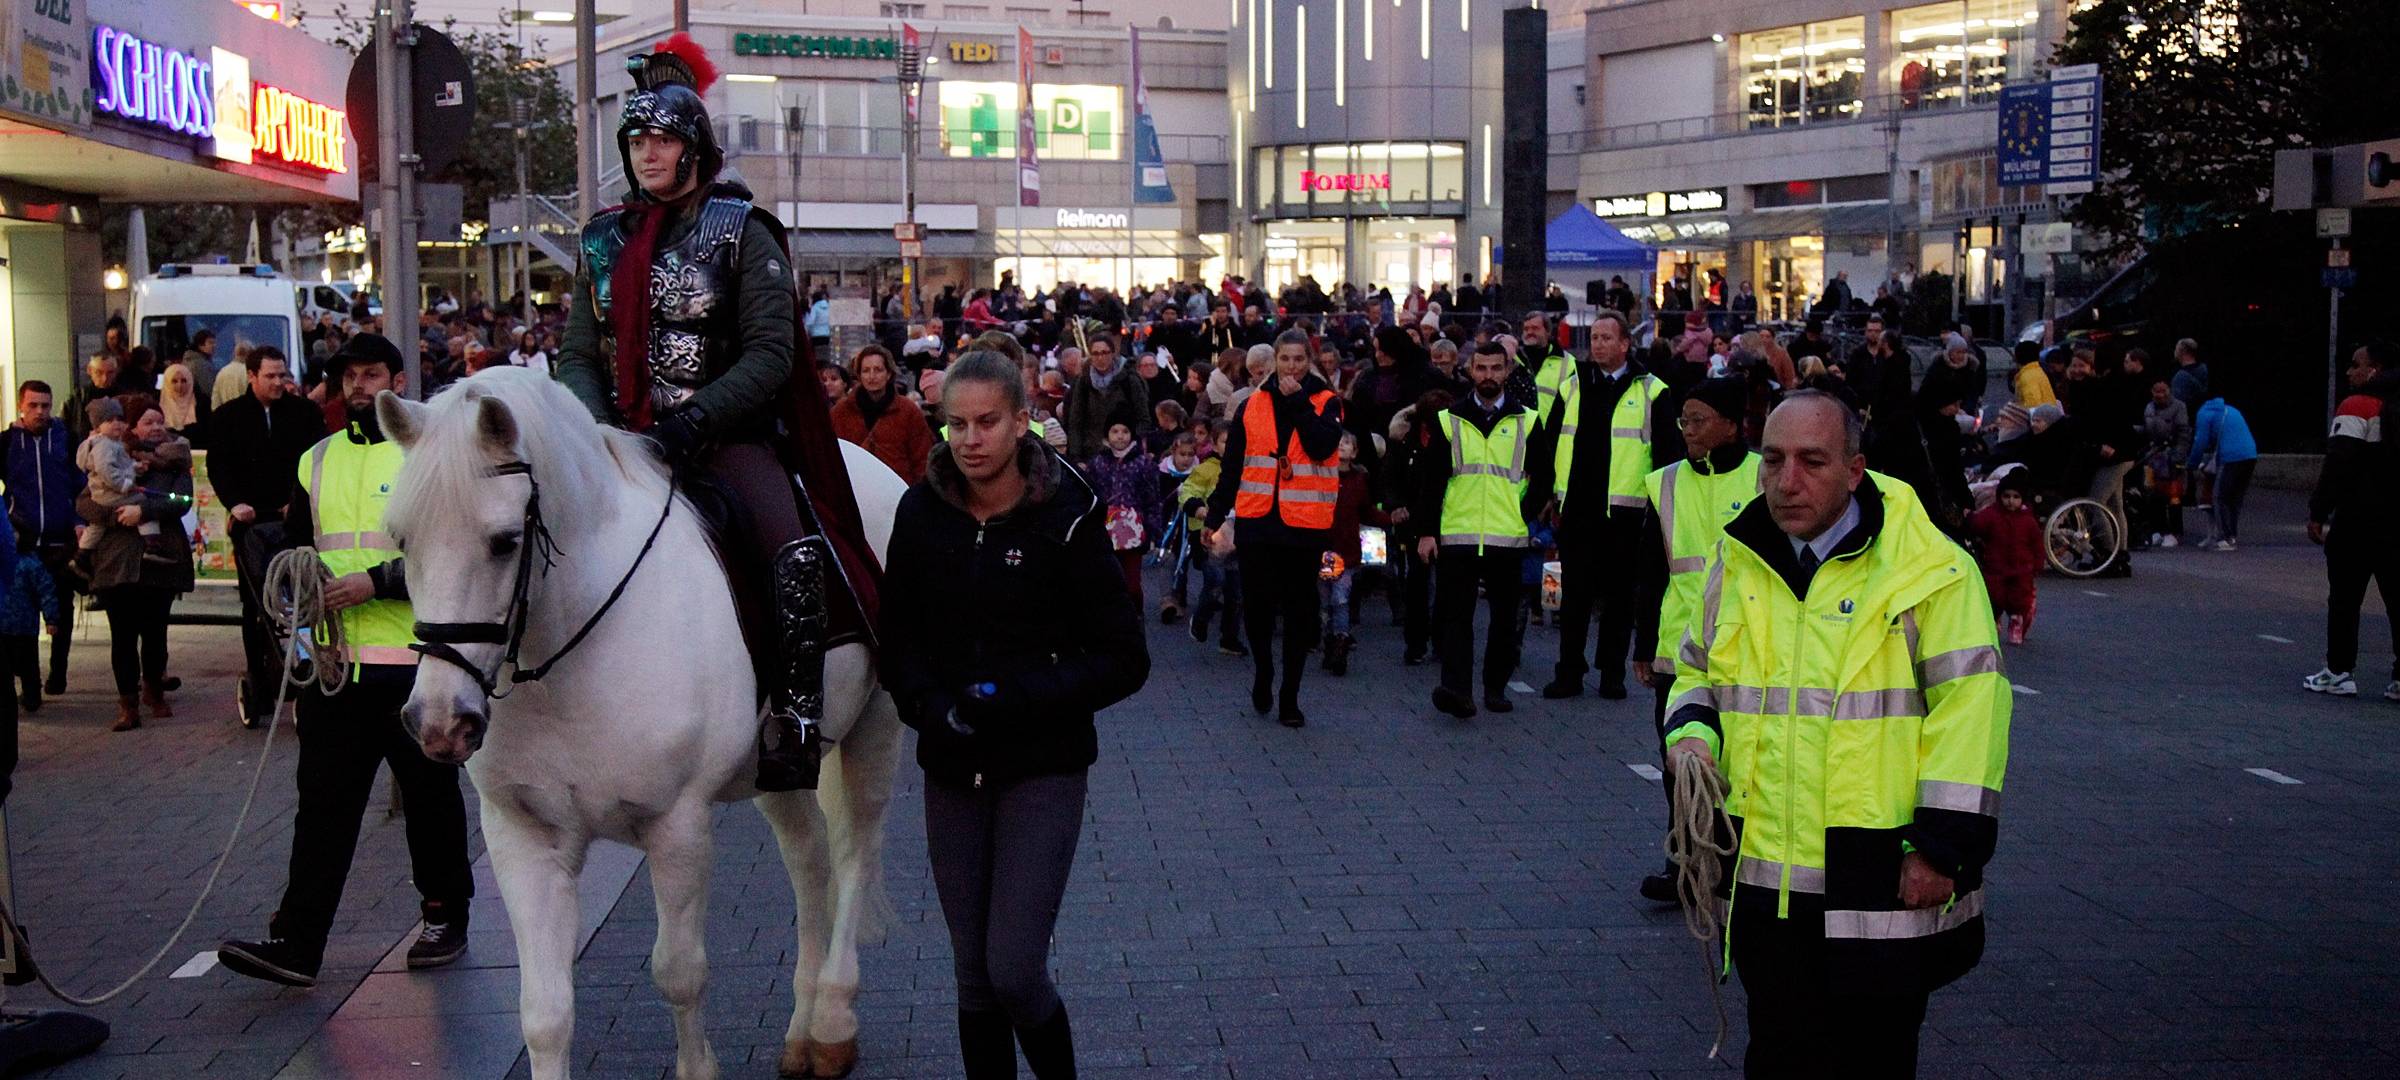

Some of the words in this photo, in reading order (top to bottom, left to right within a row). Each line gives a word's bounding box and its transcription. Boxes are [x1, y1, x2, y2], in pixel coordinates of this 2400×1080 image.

[735, 33, 901, 60] DEICHMAN
[94, 25, 216, 138] SCHLOSS
[254, 85, 348, 173] APOTHEKE
[1056, 102, 1081, 129] D
